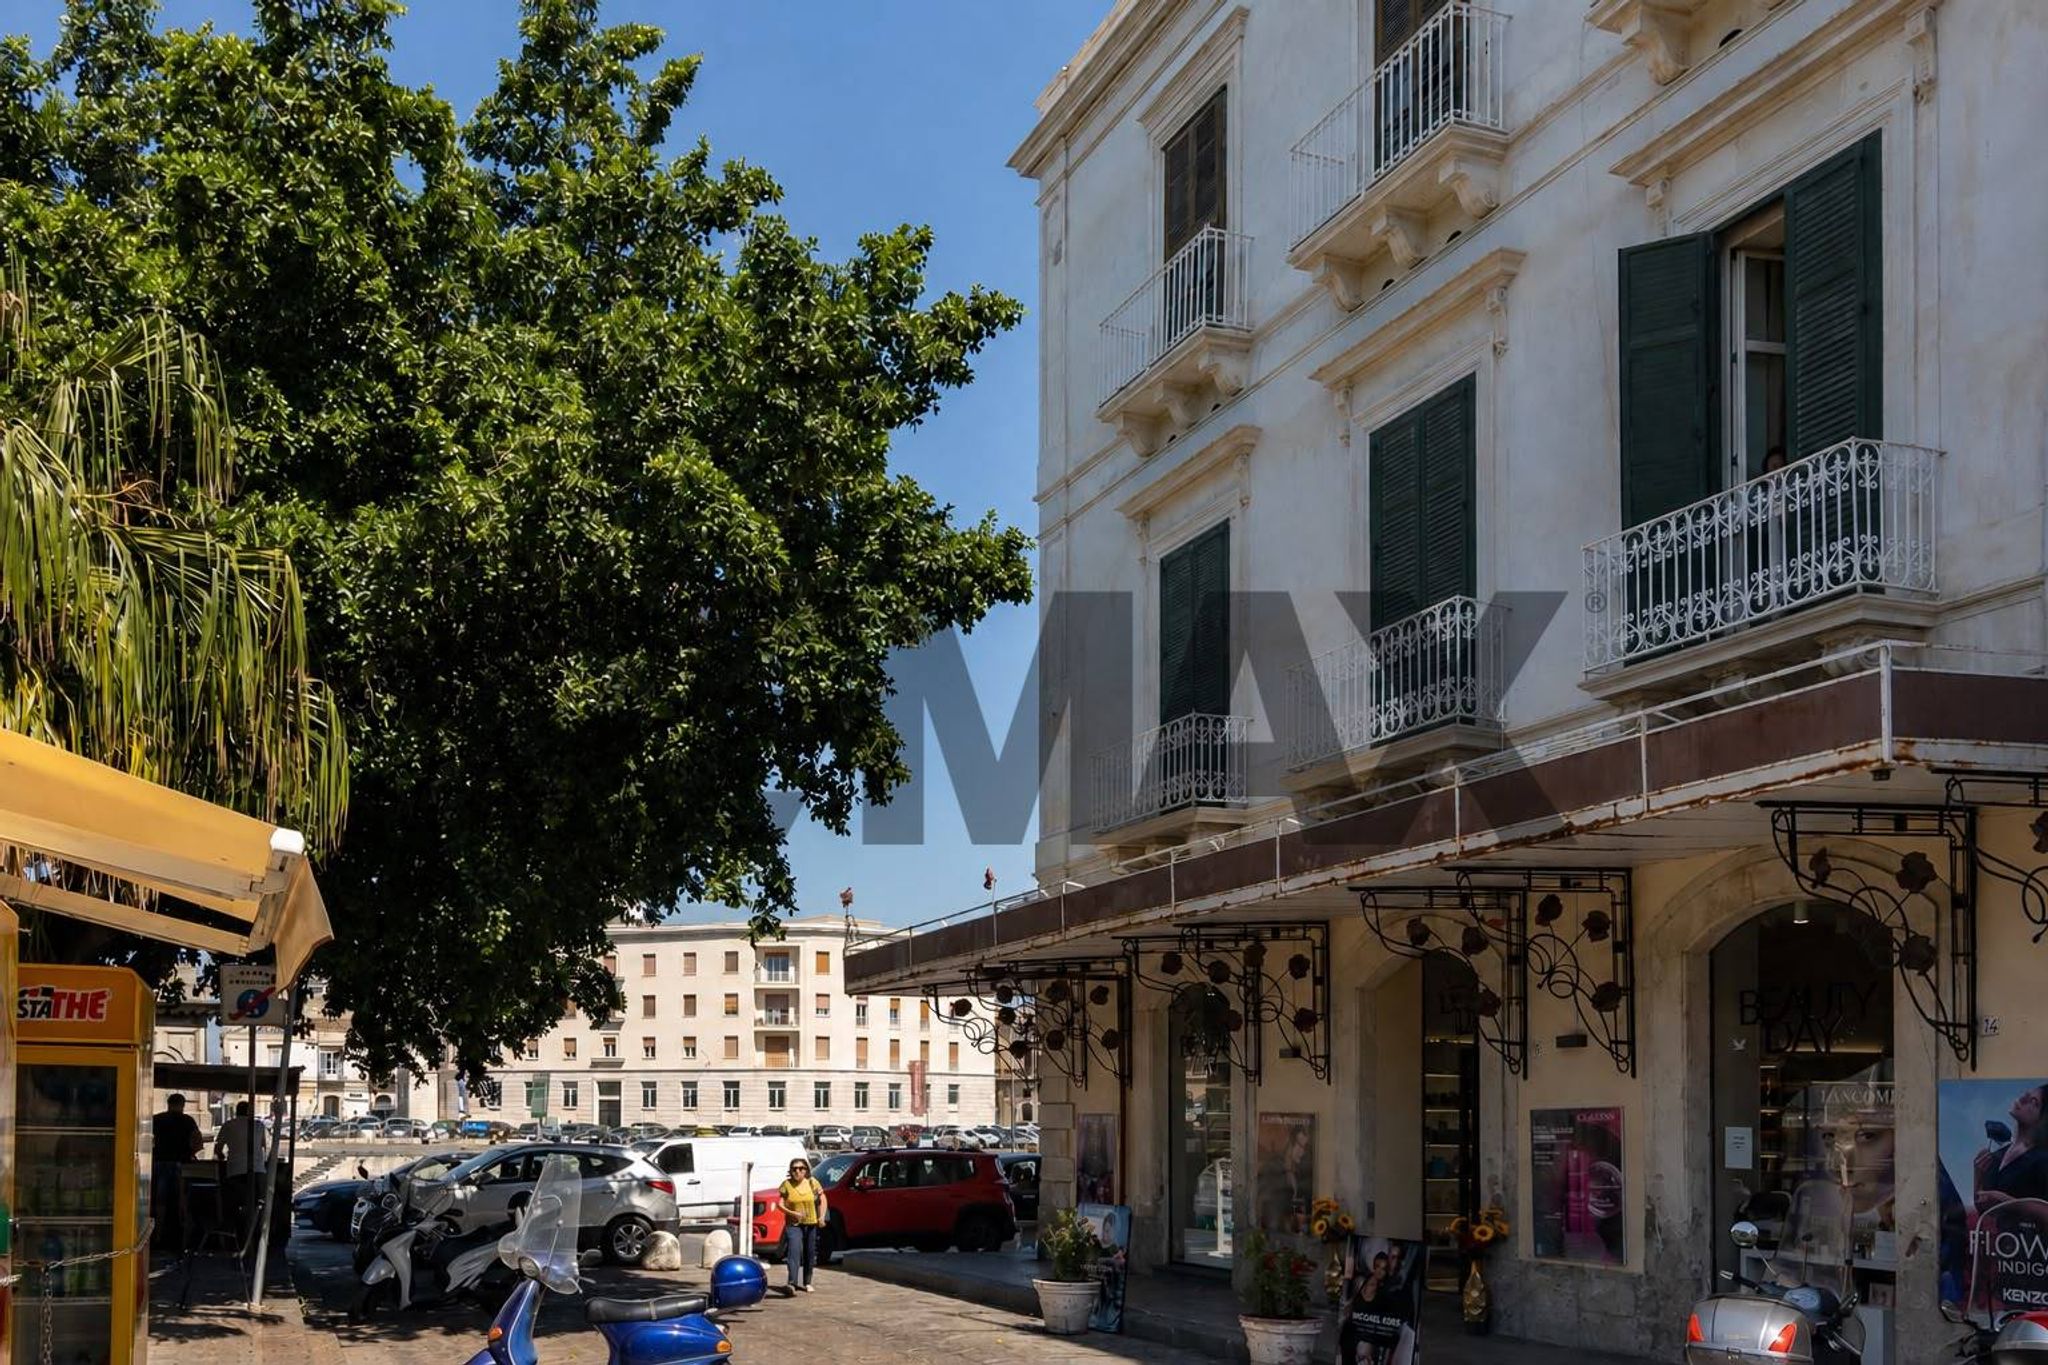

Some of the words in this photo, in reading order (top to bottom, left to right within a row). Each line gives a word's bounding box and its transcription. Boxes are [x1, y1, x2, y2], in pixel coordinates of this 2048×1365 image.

[1740, 981, 1878, 1025] BEAUTY
[1766, 1015, 1842, 1055] DAY
[1984, 1018, 1998, 1033] 14
[1998, 1260, 2048, 1276] INDIG
